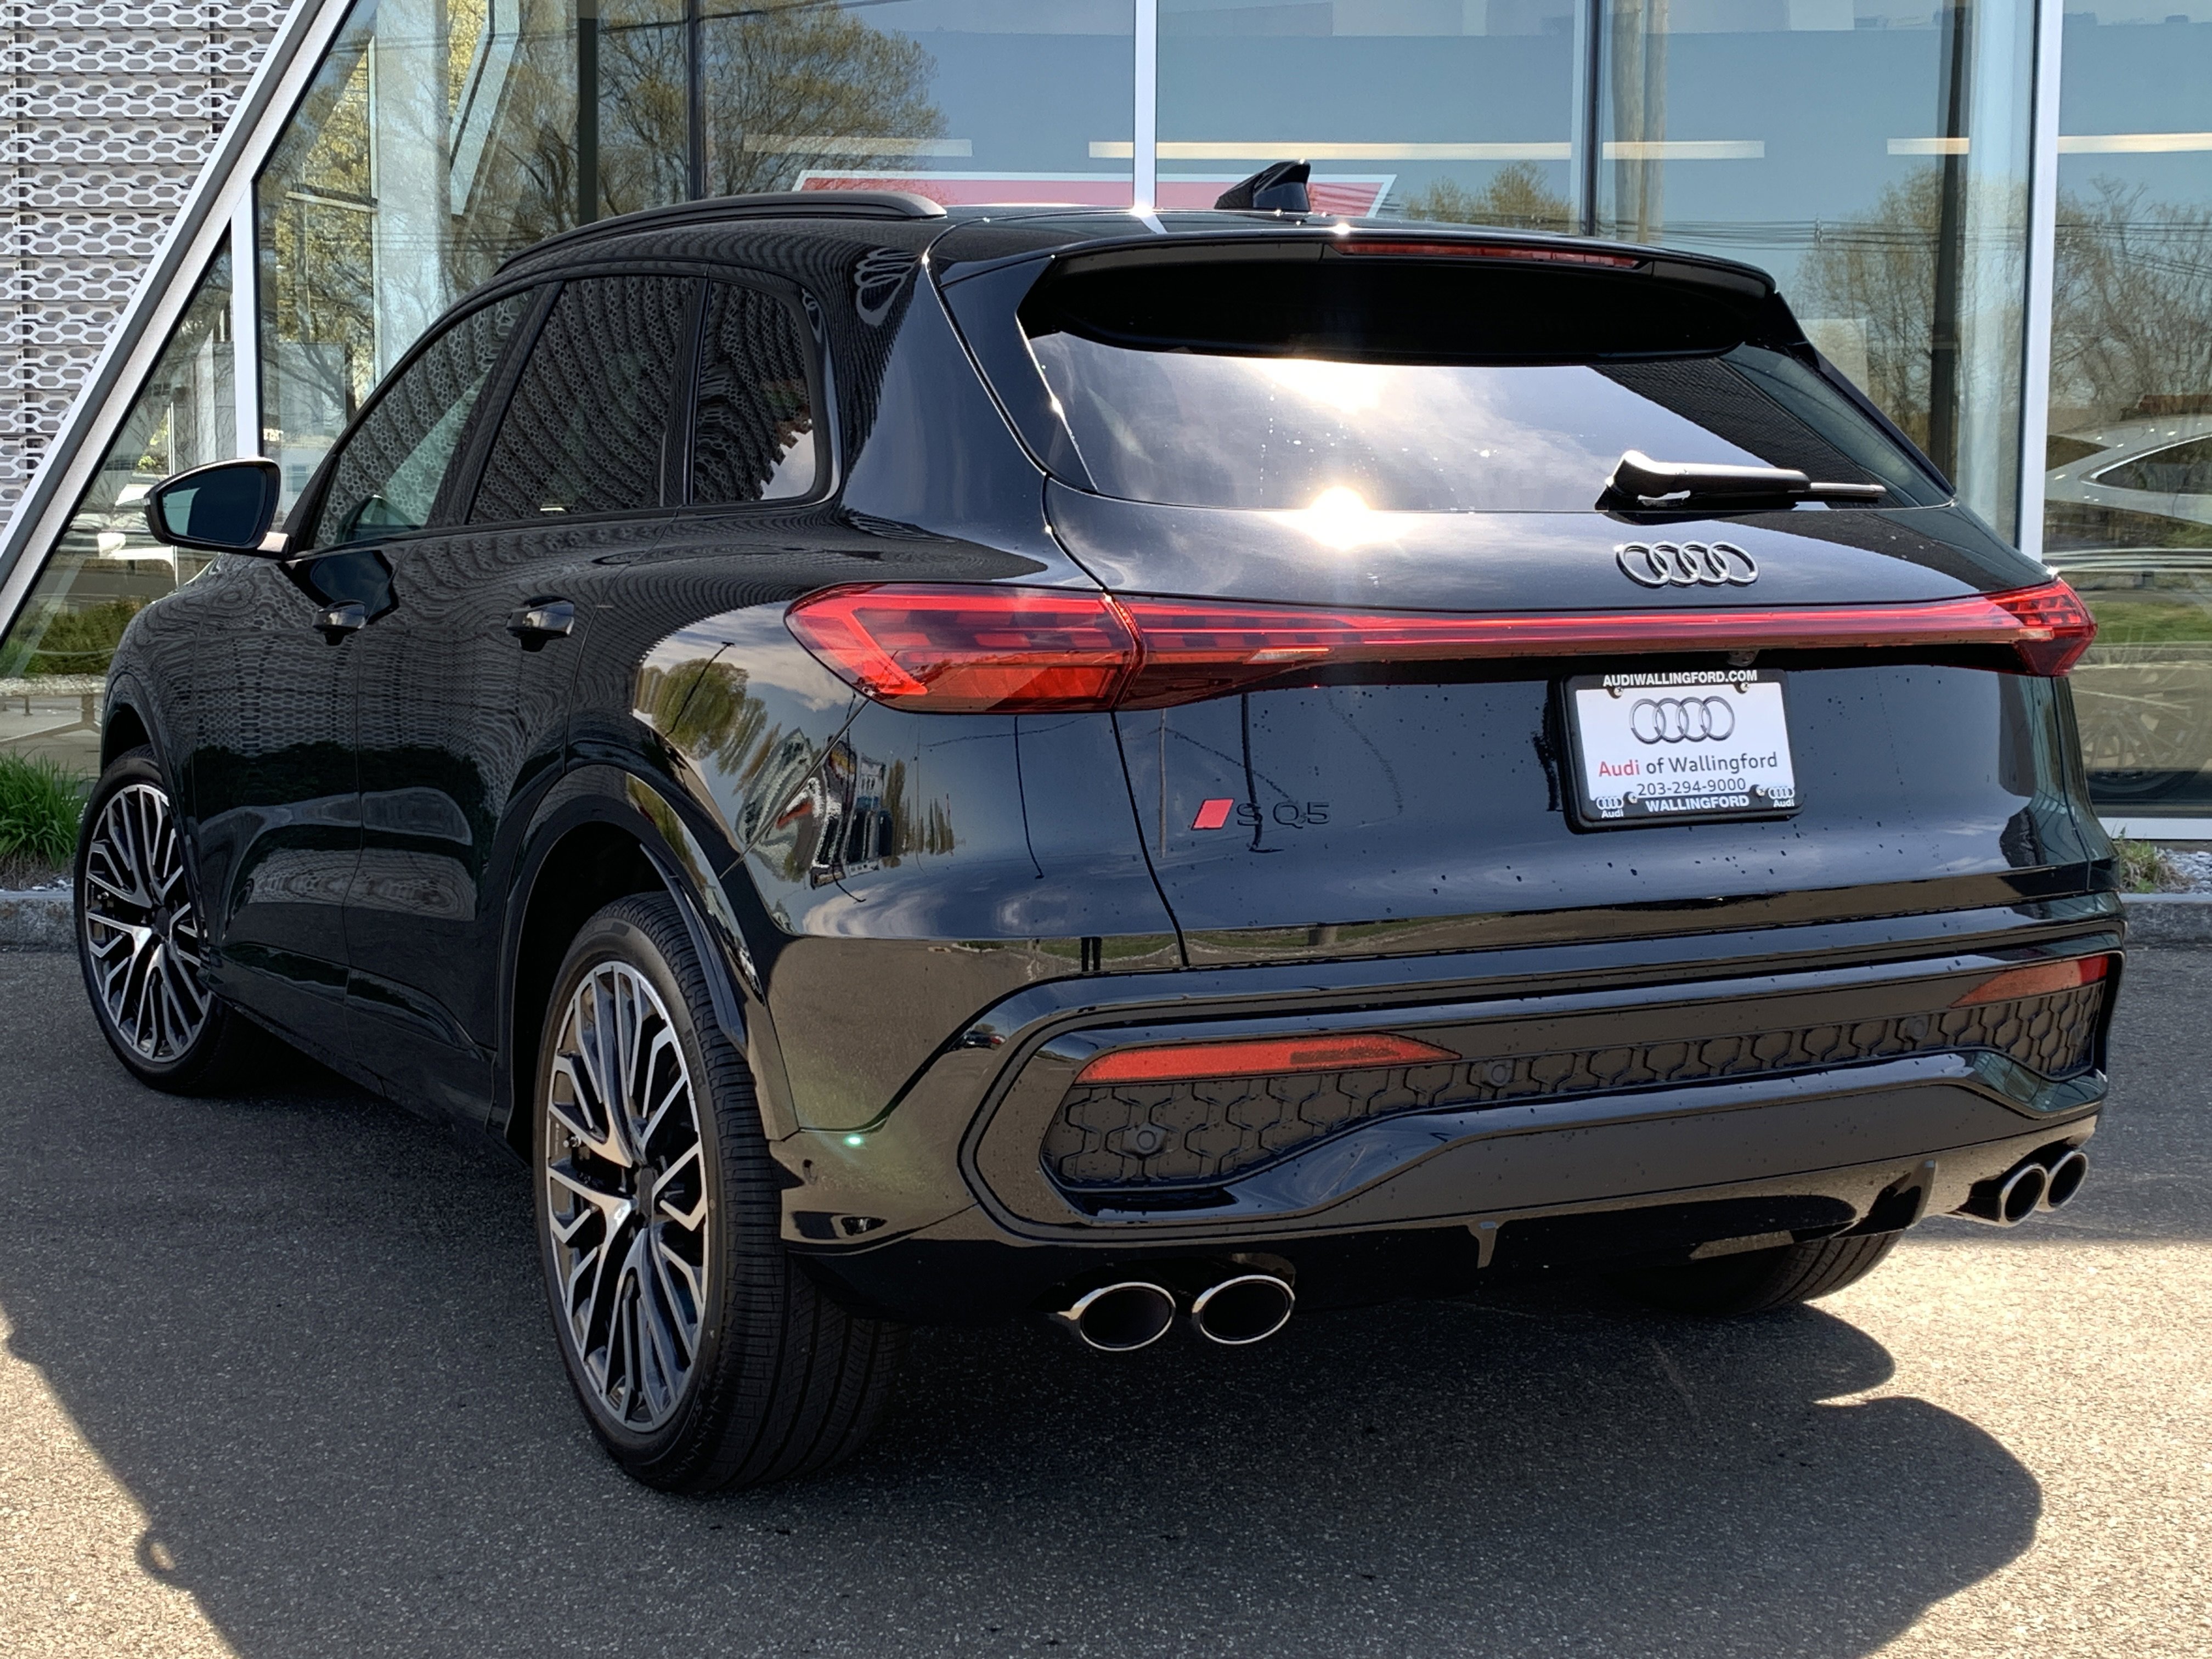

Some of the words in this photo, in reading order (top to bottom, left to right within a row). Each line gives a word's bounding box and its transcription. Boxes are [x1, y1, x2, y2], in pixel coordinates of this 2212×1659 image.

[1603, 670, 1757, 687] AUDIWALLINGFORD.COM
[1599, 759, 1640, 777] Audi
[1646, 757, 1664, 774] of
[1668, 752, 1778, 776] Wallingford
[1637, 777, 1746, 796] 203-294-9000
[1645, 795, 1750, 813] WALLINGFORD
[1773, 798, 1795, 809] Audi
[1601, 809, 1624, 819] Audi
